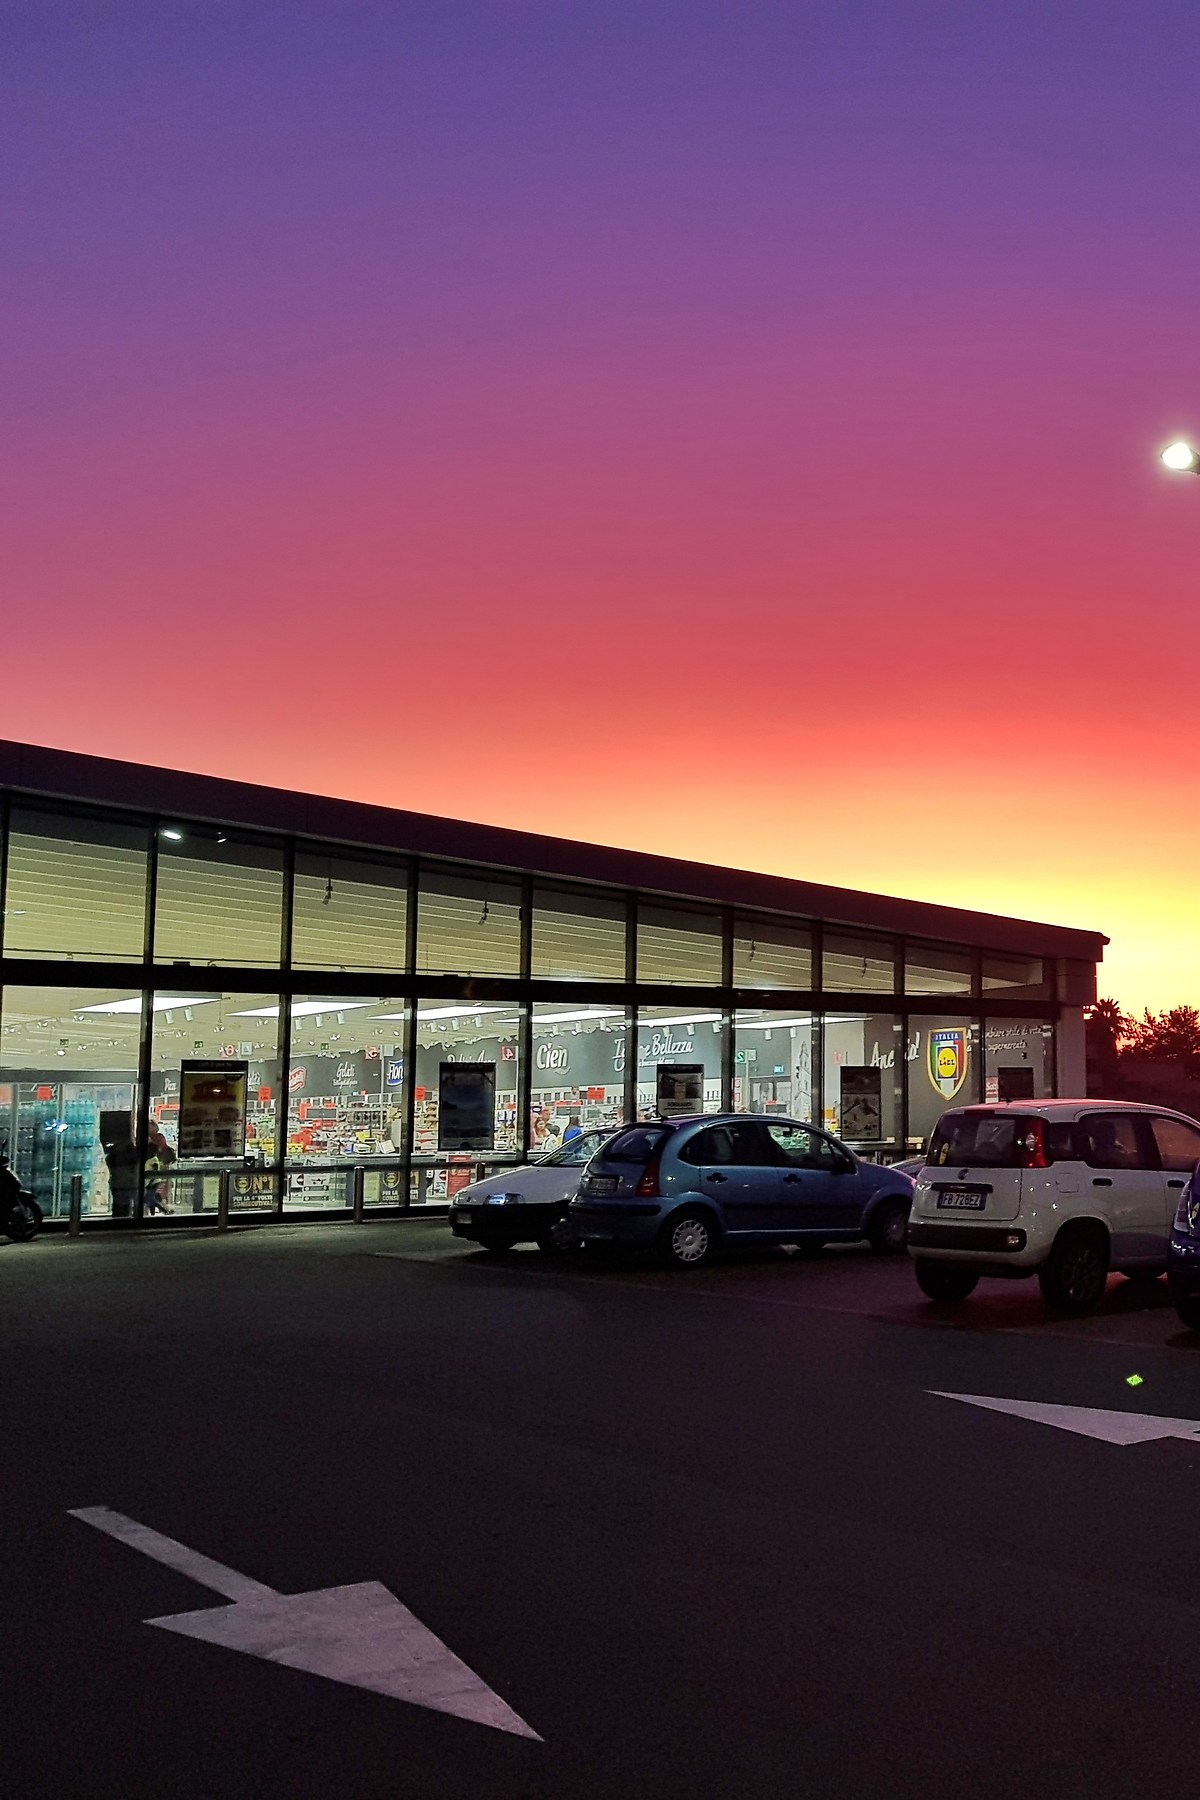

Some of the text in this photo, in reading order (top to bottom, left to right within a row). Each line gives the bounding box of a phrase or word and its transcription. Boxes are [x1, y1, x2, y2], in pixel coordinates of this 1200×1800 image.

[652, 1033, 694, 1056] Bellezza
[935, 1032, 959, 1041] ITALIA
[536, 1042, 569, 1069] Cien
